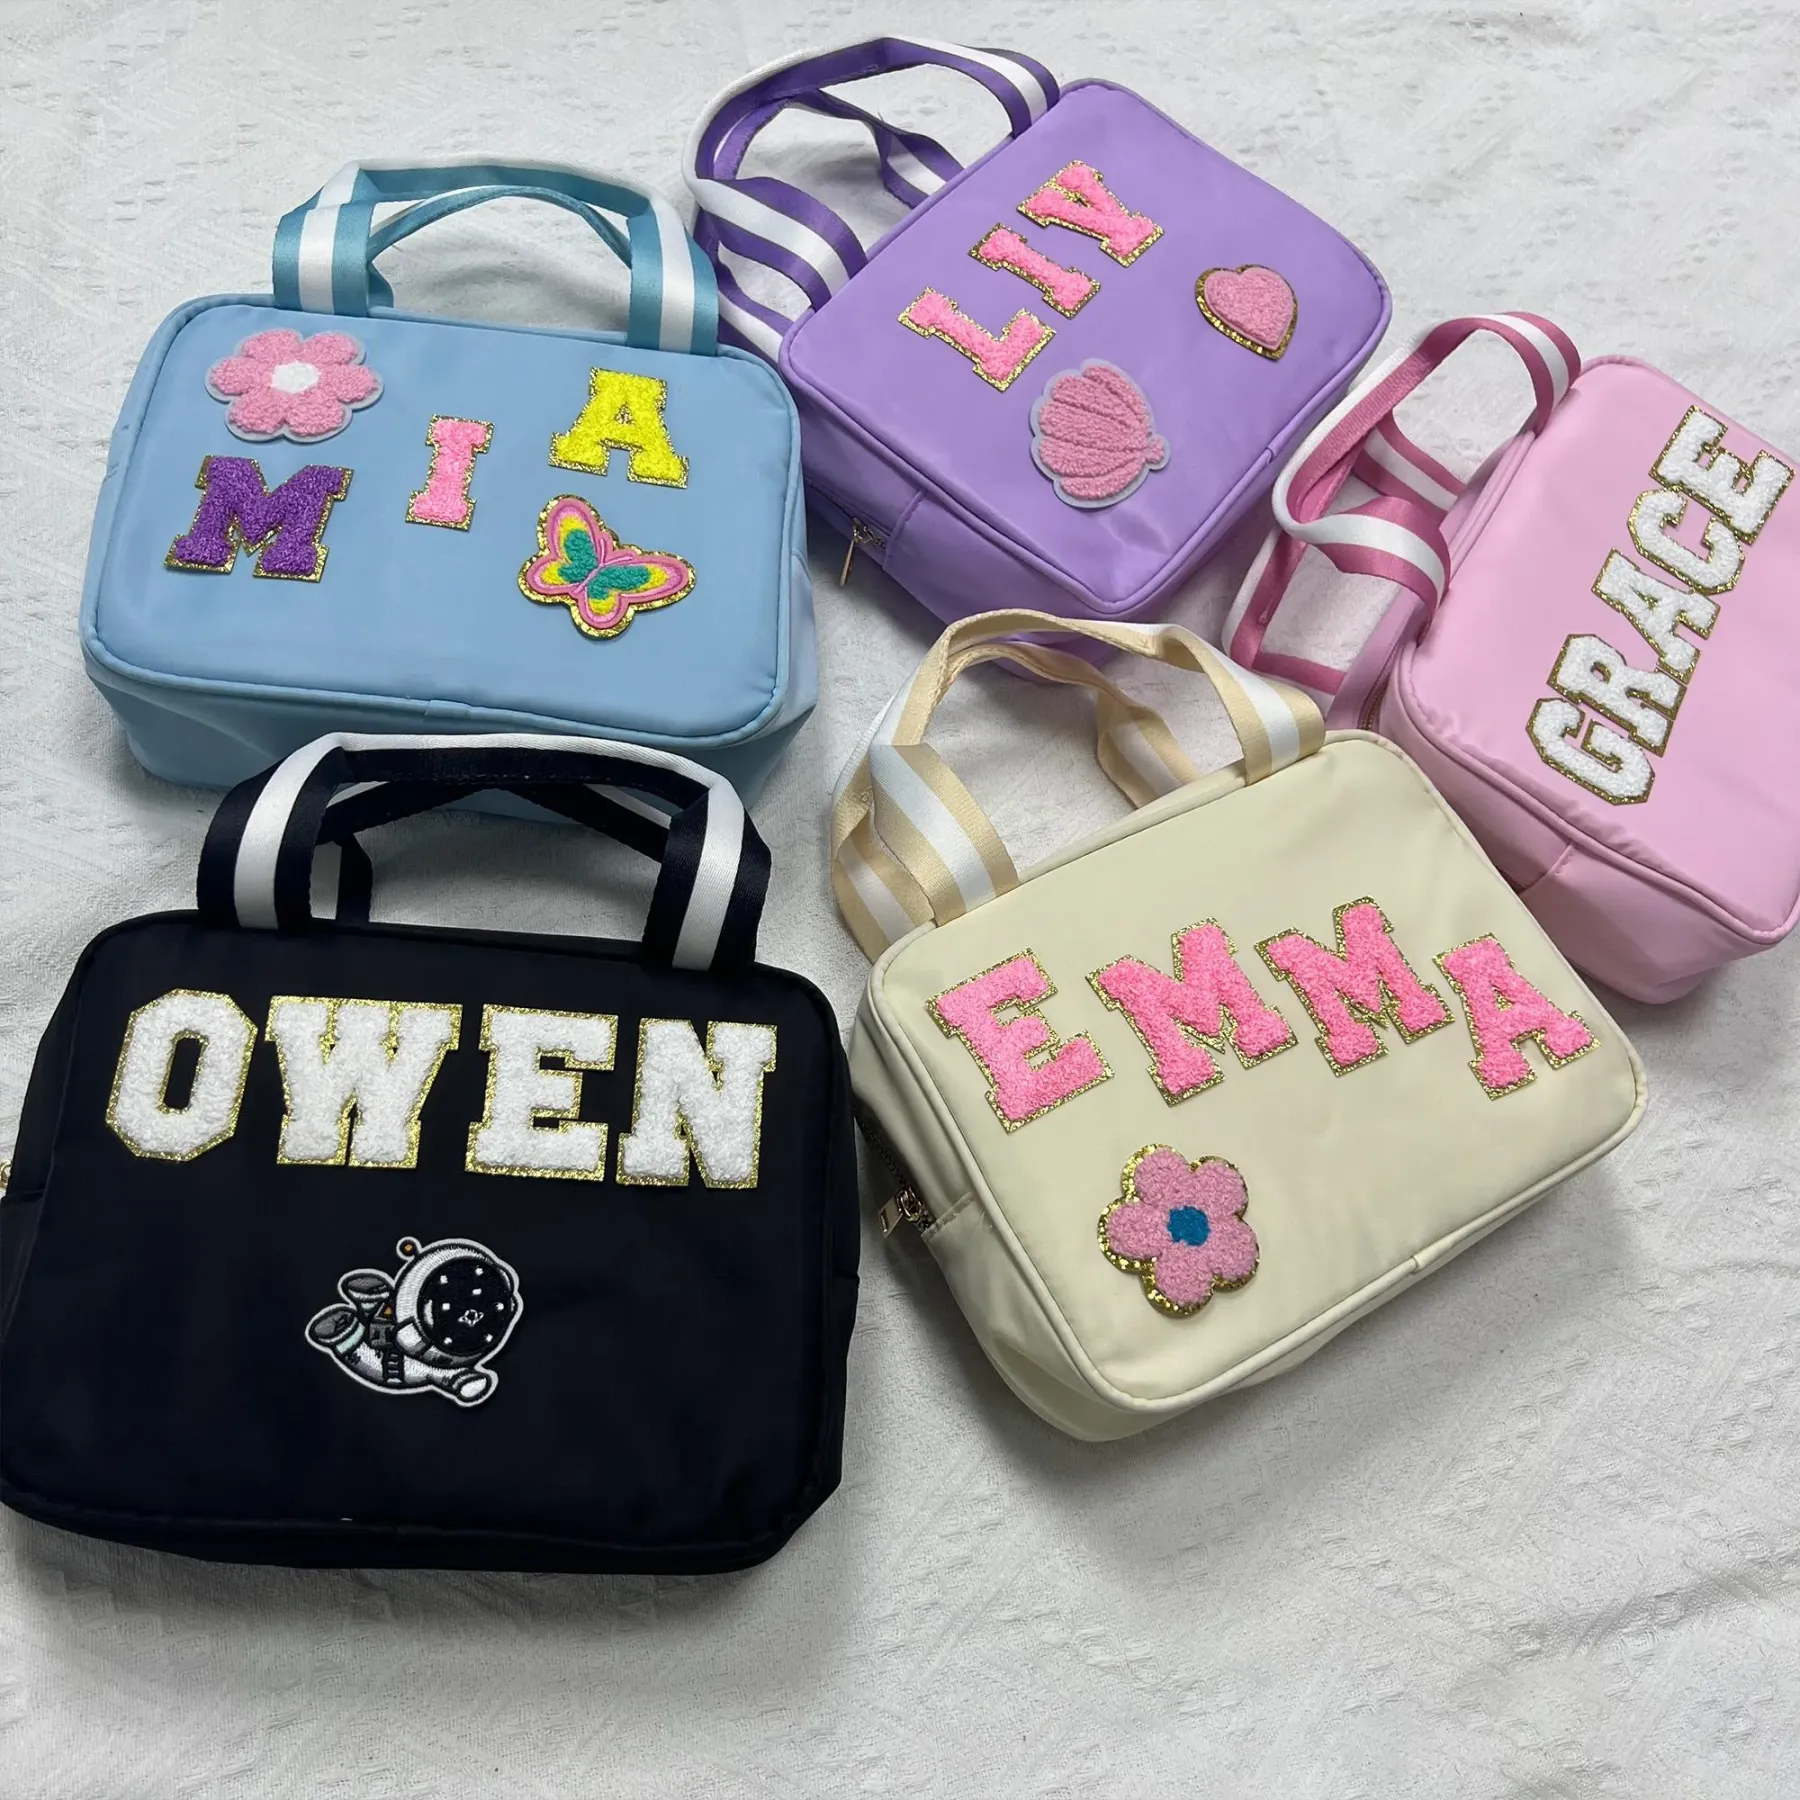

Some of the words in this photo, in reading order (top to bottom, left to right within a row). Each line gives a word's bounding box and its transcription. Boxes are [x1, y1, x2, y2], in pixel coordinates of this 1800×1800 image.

[898, 160, 1164, 393] LIY
[164, 366, 690, 583] MIA
[1525, 405, 1795, 806] GRACE
[105, 988, 778, 1189] OWEN
[926, 896, 1601, 1133] EMMA
